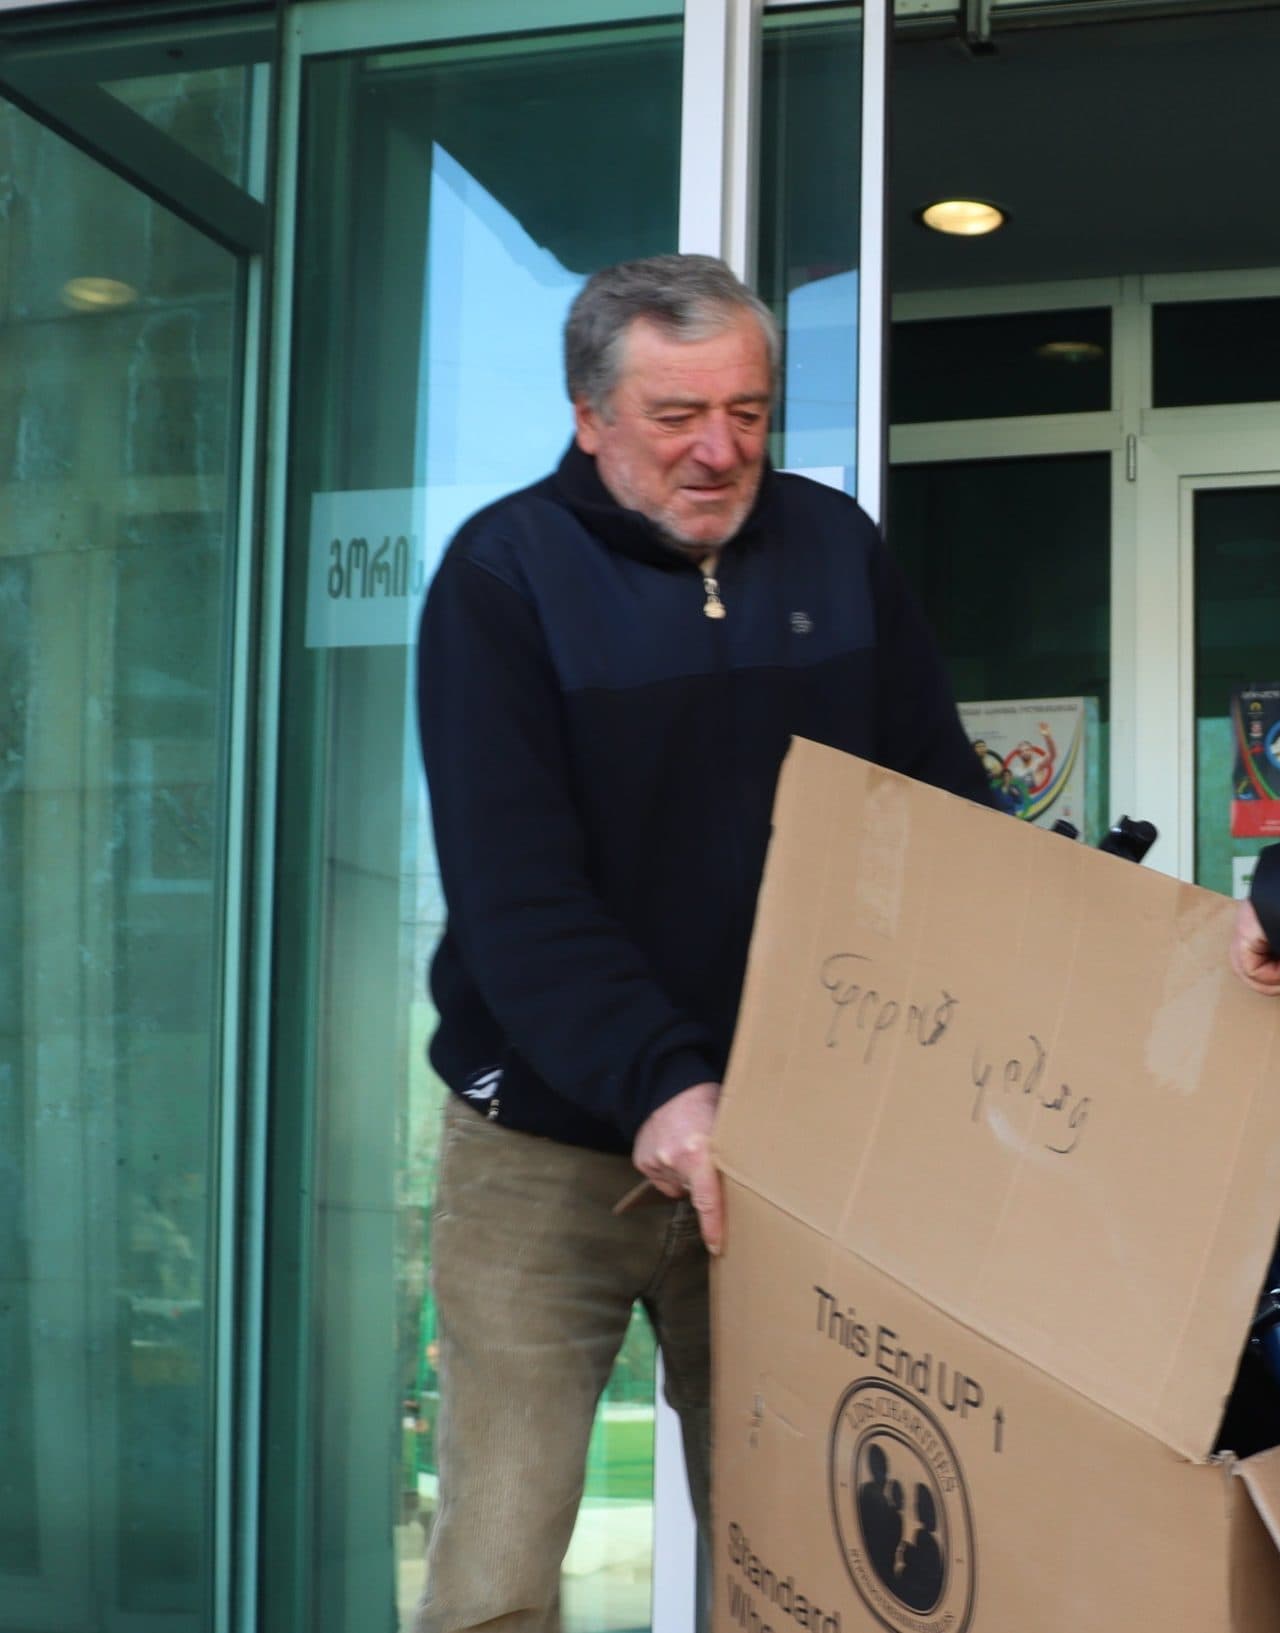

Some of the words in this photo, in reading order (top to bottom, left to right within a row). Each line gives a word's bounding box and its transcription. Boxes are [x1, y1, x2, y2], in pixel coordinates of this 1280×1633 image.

[813, 1285, 870, 1358] This
[875, 1324, 932, 1396] End
[937, 1361, 984, 1419] UP
[727, 1521, 842, 1633] Standard
